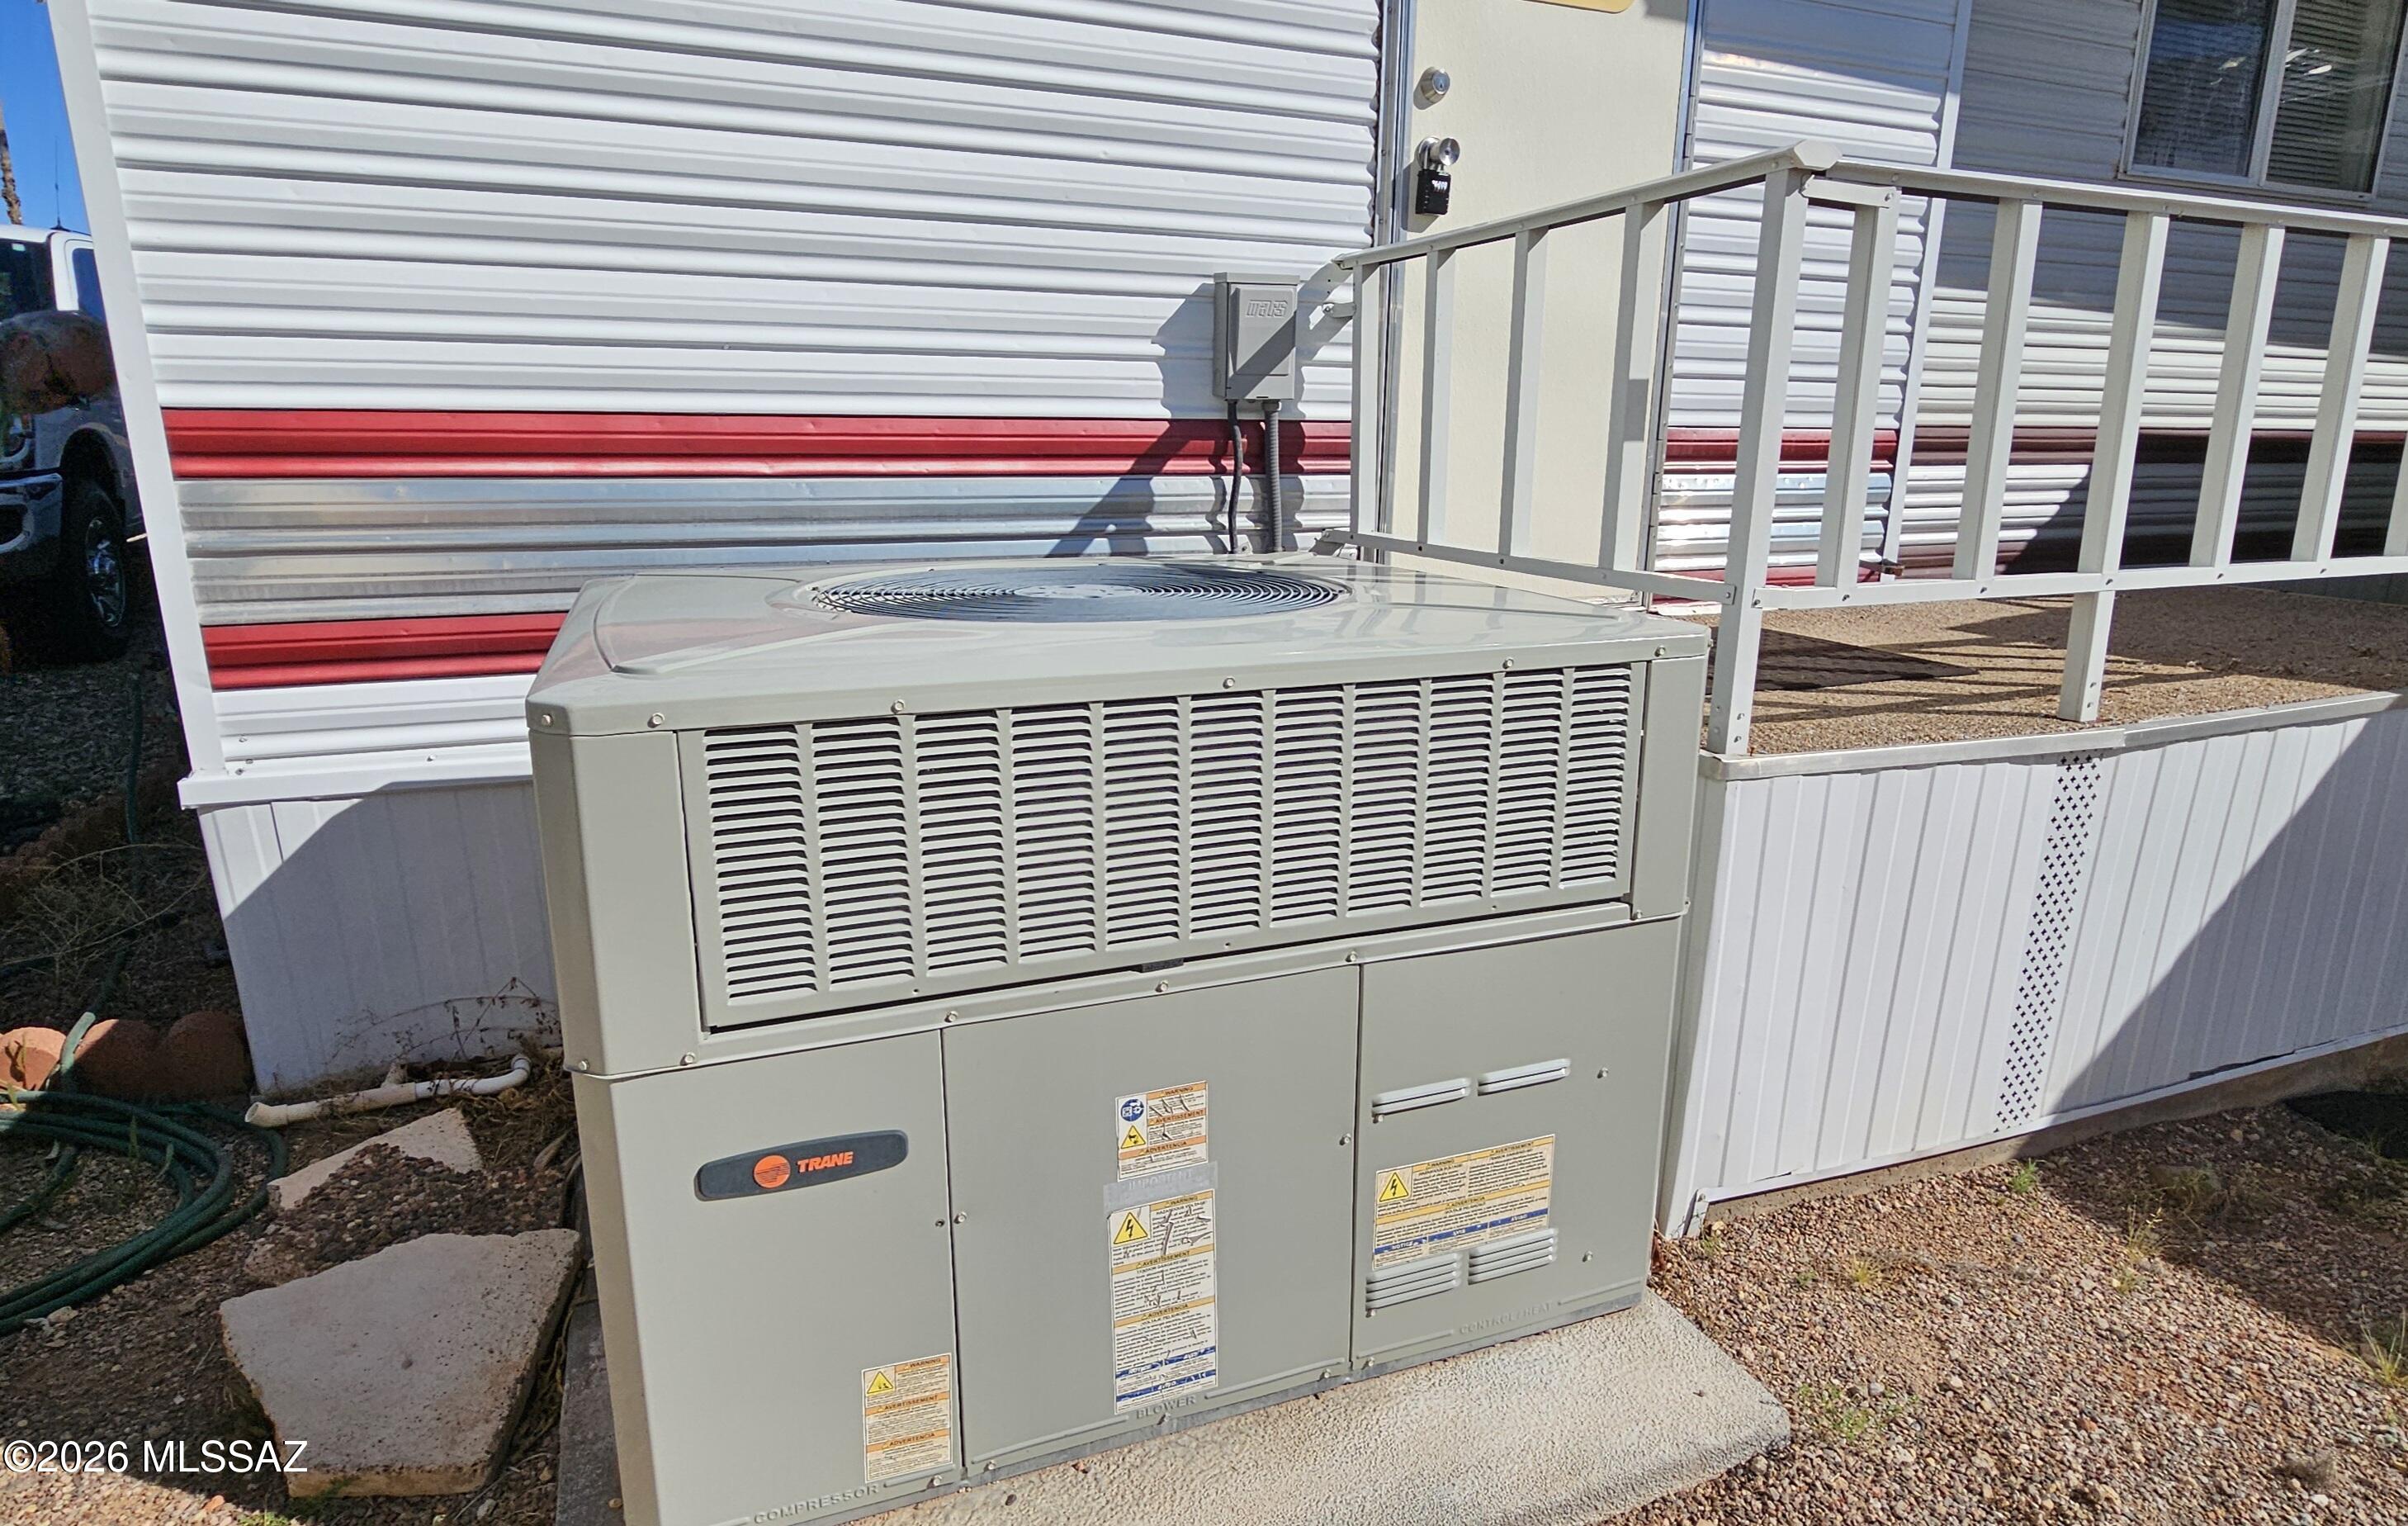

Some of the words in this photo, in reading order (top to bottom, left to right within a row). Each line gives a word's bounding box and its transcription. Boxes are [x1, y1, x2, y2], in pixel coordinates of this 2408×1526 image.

[1165, 1085, 1194, 1095] WARNING
[796, 1150, 854, 1174] TRANE
[910, 1358, 942, 1368] WARNING
[884, 1395, 939, 1410] AVERTISSEMENT
[1136, 1396, 1196, 1419] BLOWER
[889, 1432, 936, 1447] ADVERTENCIA
[753, 1482, 880, 1525] COMPRESSOR
